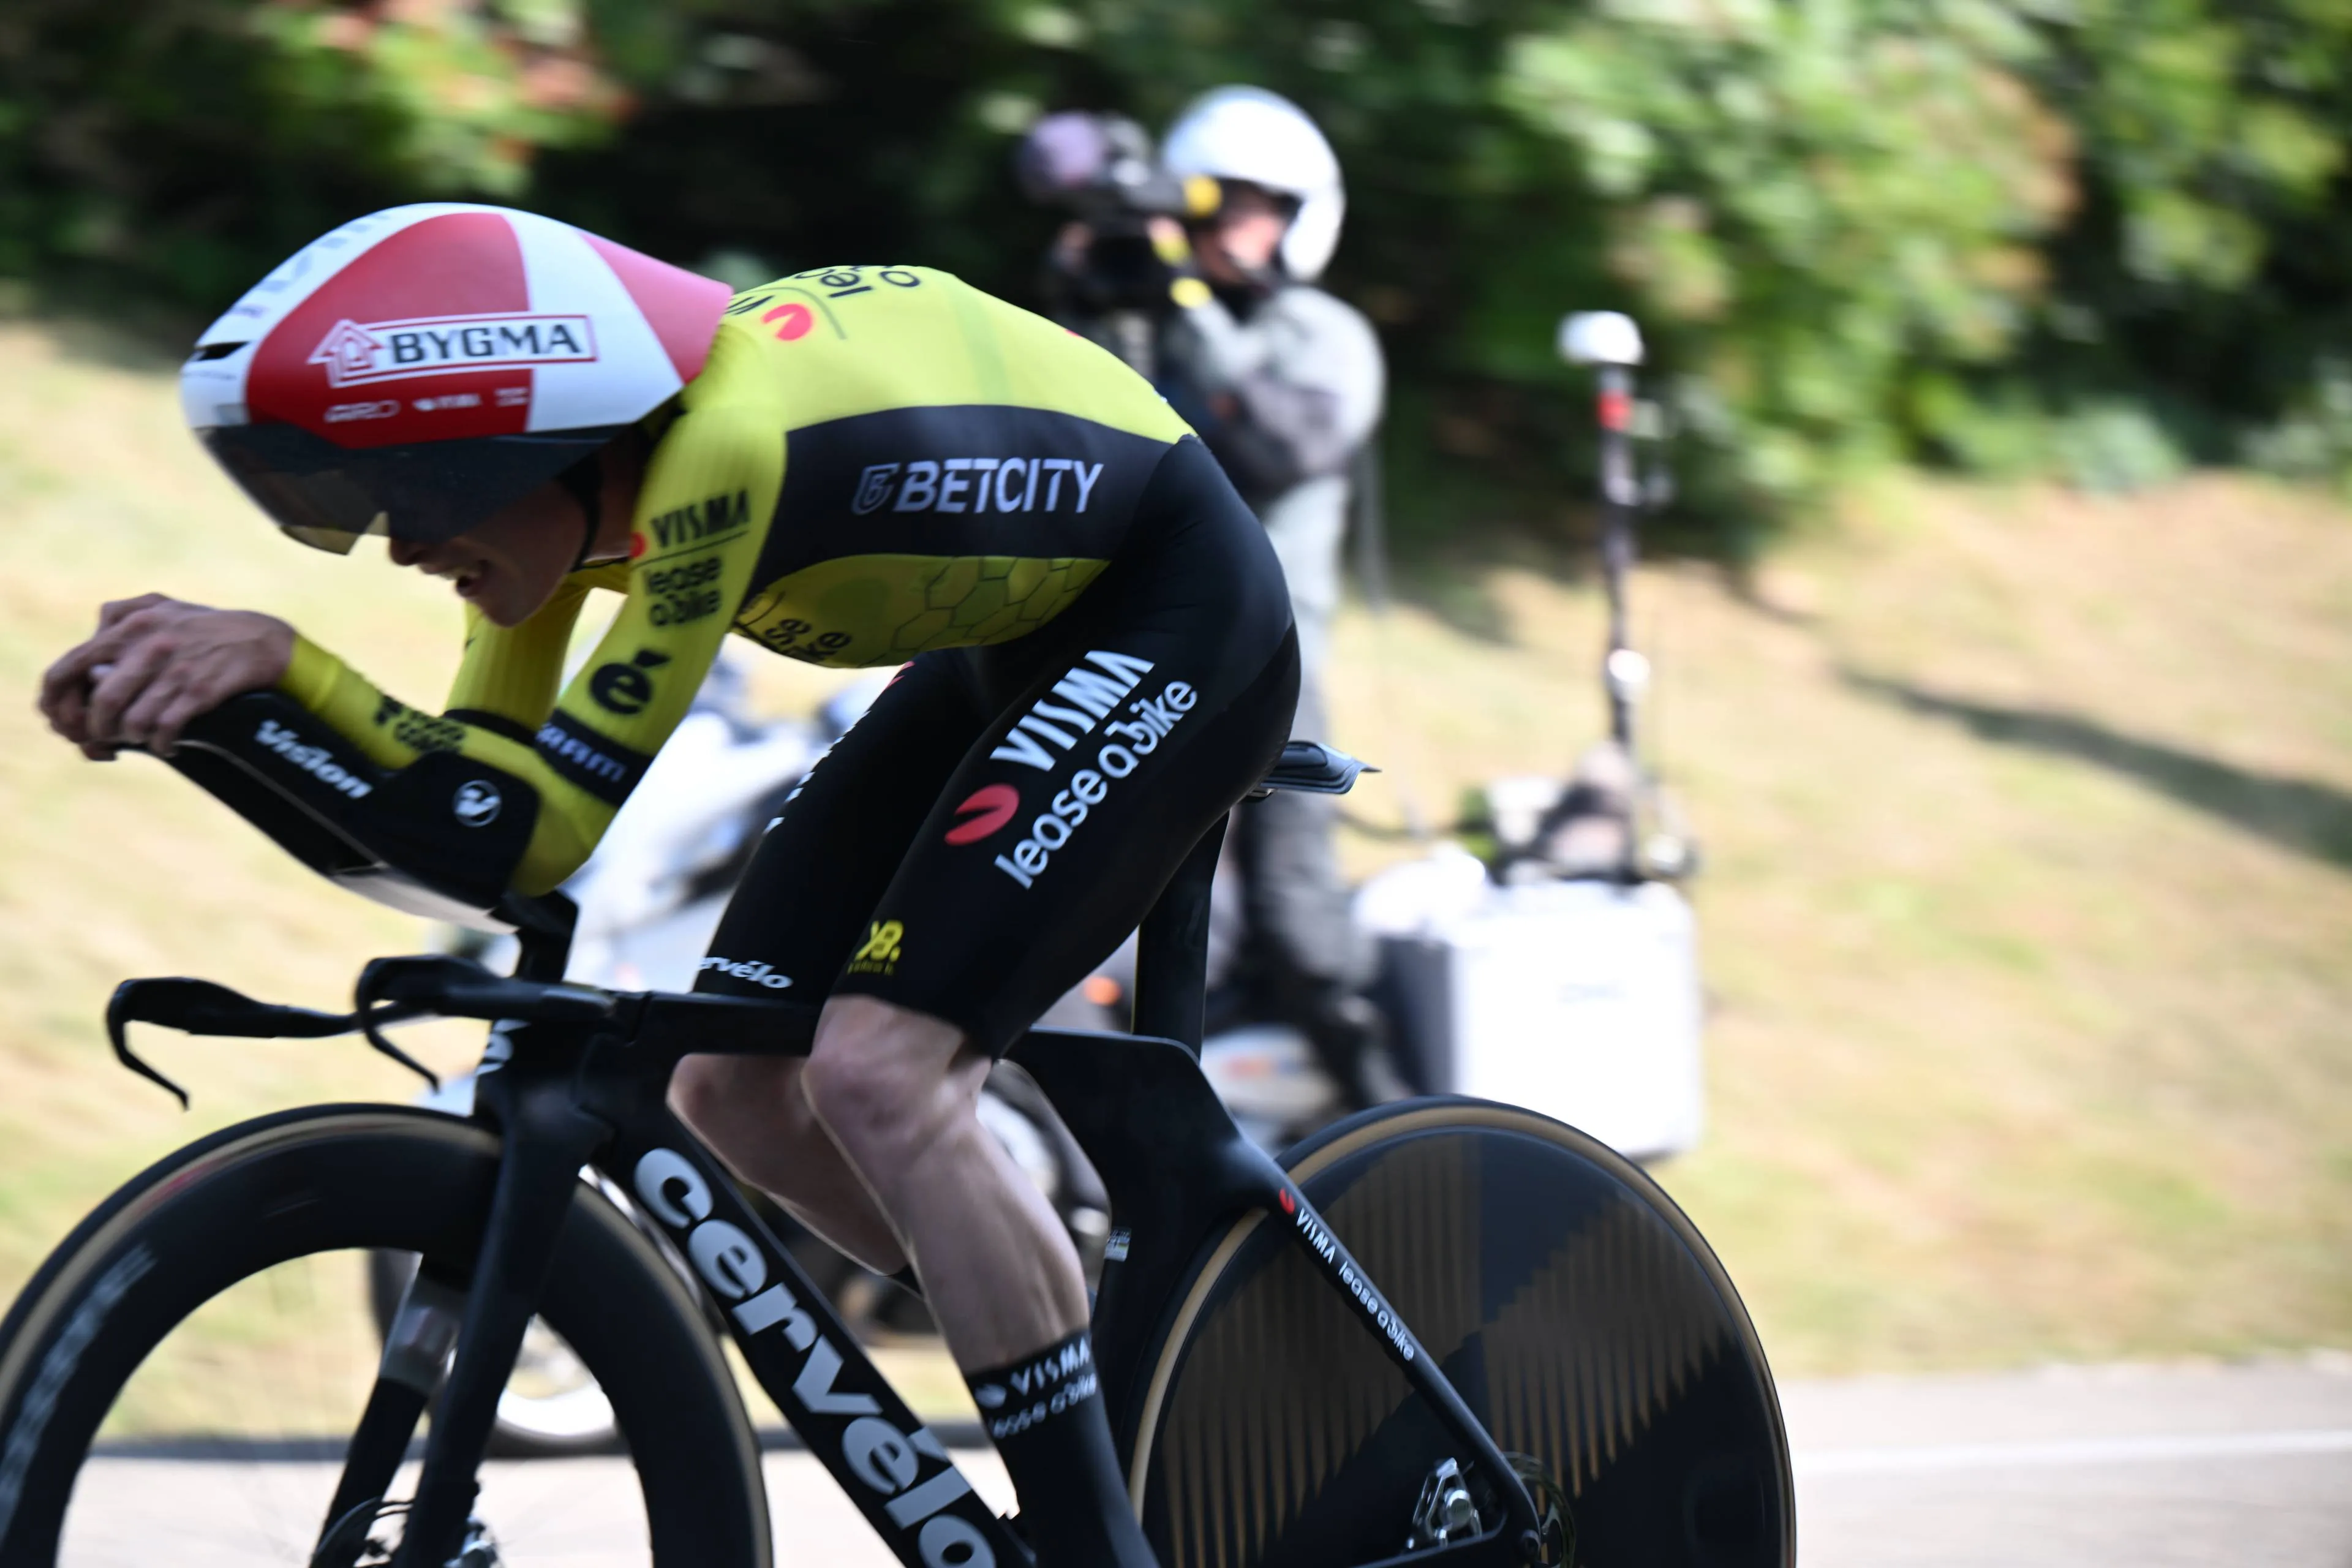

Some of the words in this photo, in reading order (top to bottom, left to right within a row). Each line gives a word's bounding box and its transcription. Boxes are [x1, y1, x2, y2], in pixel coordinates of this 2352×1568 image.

[390, 324, 581, 364] BYGMA
[893, 458, 1104, 513] BETCITY
[650, 489, 750, 549] VISMA
[643, 556, 722, 595] lease
[990, 650, 1155, 772] VISMA
[995, 769, 1107, 889] lease
[700, 957, 793, 988] ervélo
[1297, 1207, 1336, 1265] VISMA
[1338, 1260, 1378, 1314] lease
[634, 1147, 997, 1568] cervélo
[1011, 1336, 1090, 1396] VISMA
